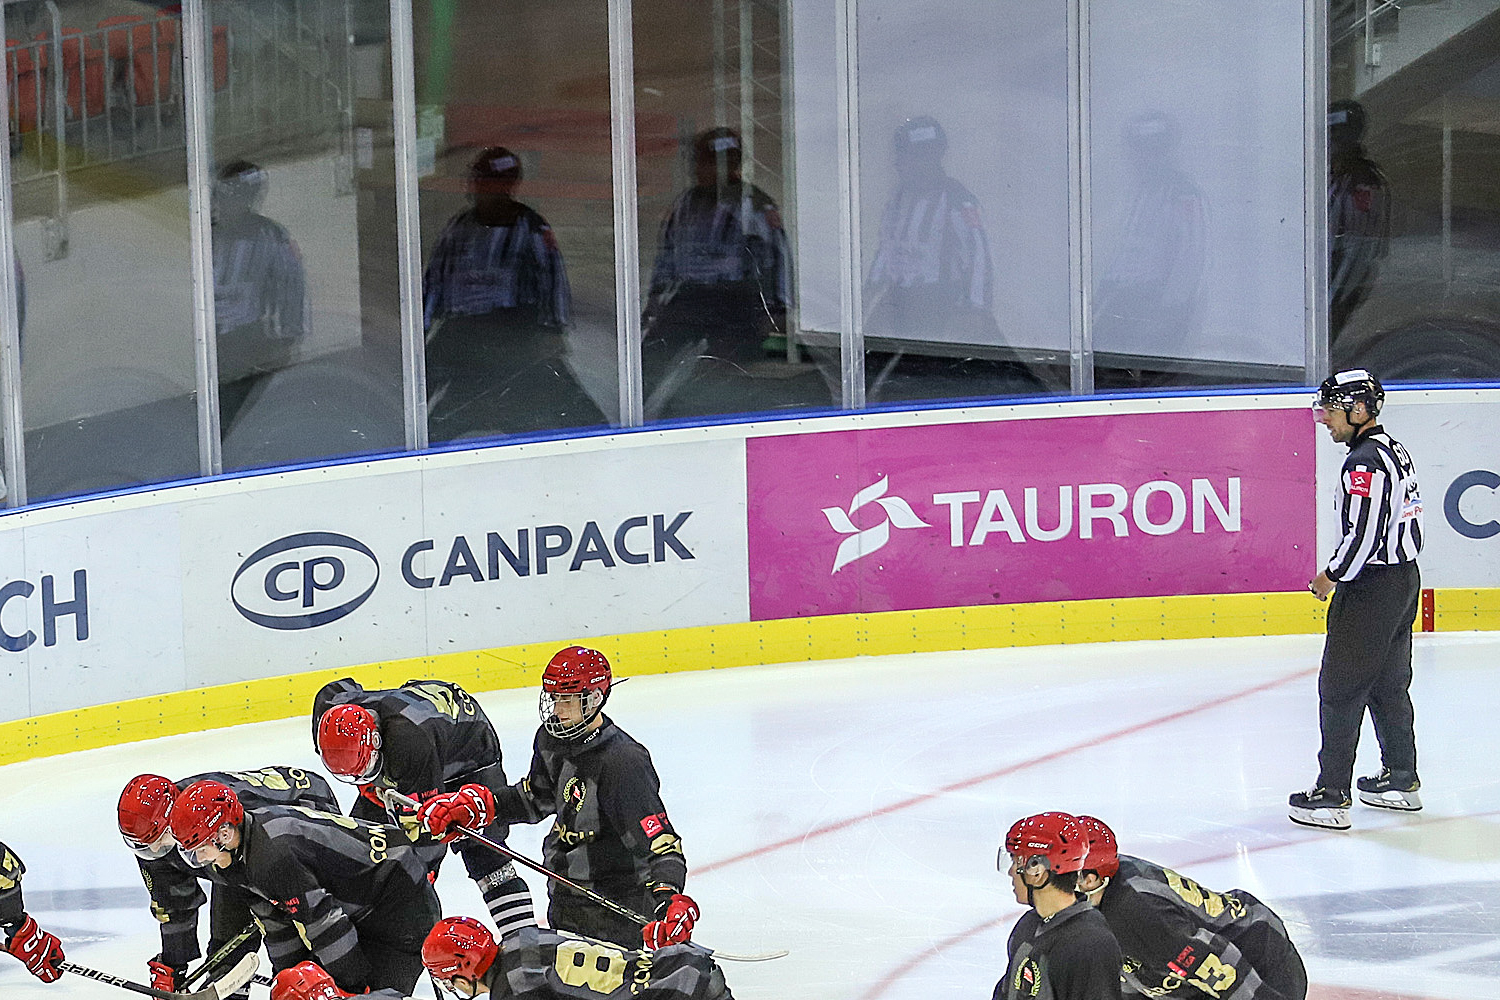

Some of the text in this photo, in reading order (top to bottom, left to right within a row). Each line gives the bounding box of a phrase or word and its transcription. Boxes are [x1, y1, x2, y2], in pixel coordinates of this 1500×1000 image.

[932, 477, 1241, 548] TAURON
[401, 510, 696, 589] CANPACK
[58, 961, 128, 989] BAUER
[554, 939, 628, 995] 8
